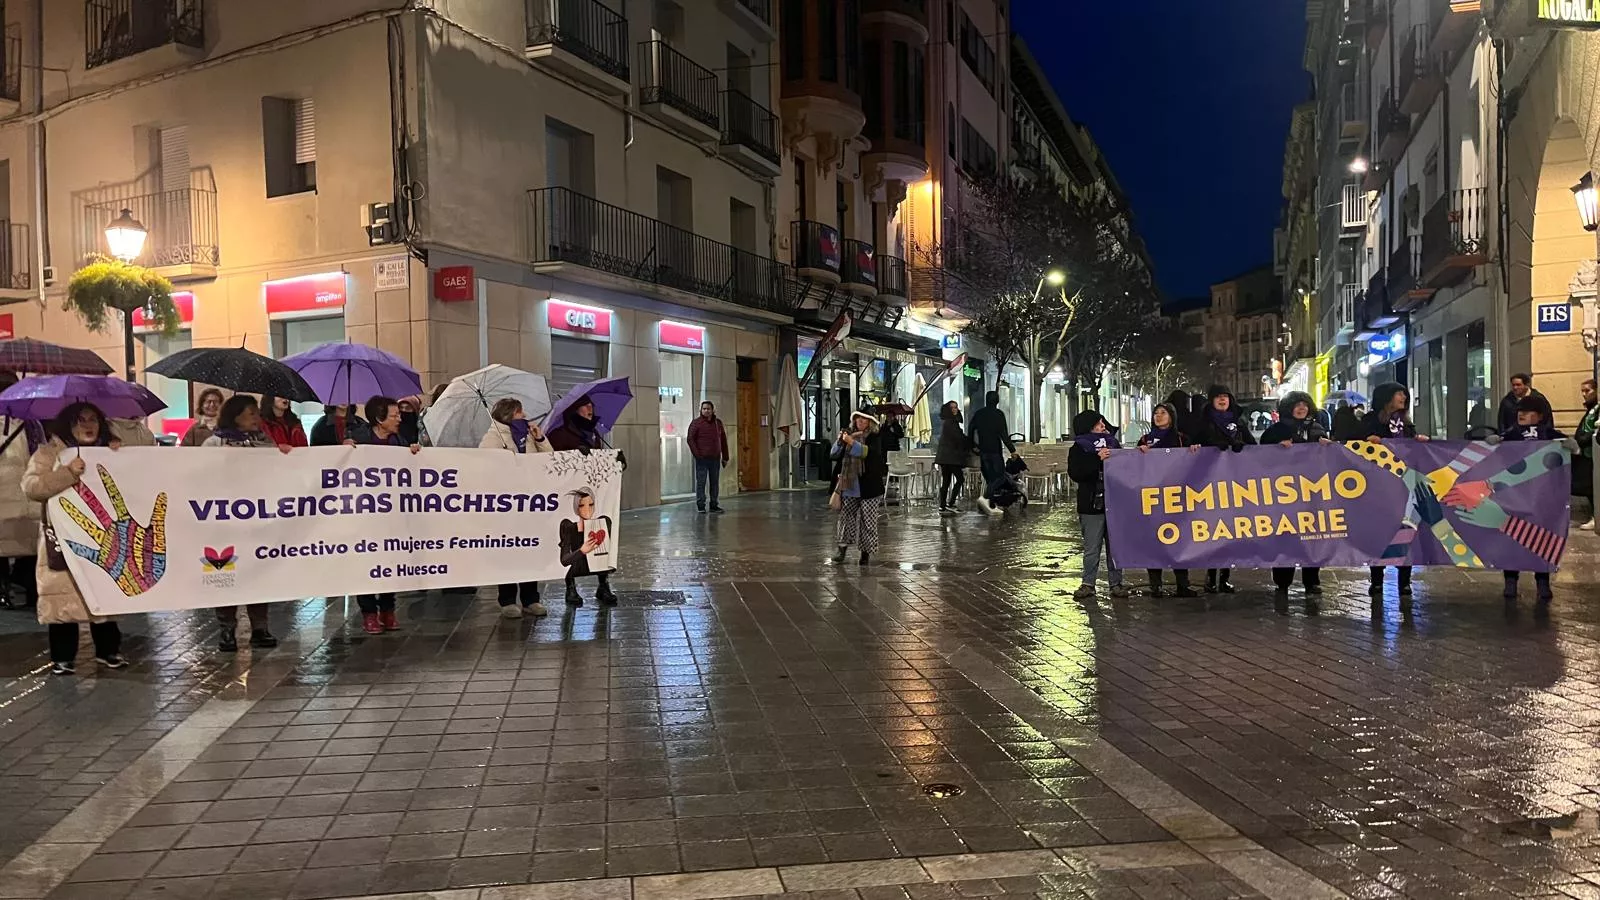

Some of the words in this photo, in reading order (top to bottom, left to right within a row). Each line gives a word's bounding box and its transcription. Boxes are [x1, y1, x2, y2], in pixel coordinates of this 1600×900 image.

[443, 276, 467, 287] GAES
[566, 309, 596, 329] GAES
[1541, 305, 1568, 322] HS
[321, 467, 412, 489] BASTA
[419, 468, 458, 488] DE
[1141, 469, 1367, 515] FEMINISMO
[188, 493, 393, 520] VIOLENCIAS
[400, 492, 559, 513] MACHISTAS
[1157, 522, 1180, 545] O
[1191, 508, 1348, 542] BARBARIE
[255, 540, 348, 559] Colectivo
[354, 539, 378, 553] de
[384, 536, 444, 554] Mujeres
[449, 534, 540, 549] Feministas
[370, 564, 392, 579] de
[397, 563, 448, 578] Huesca
